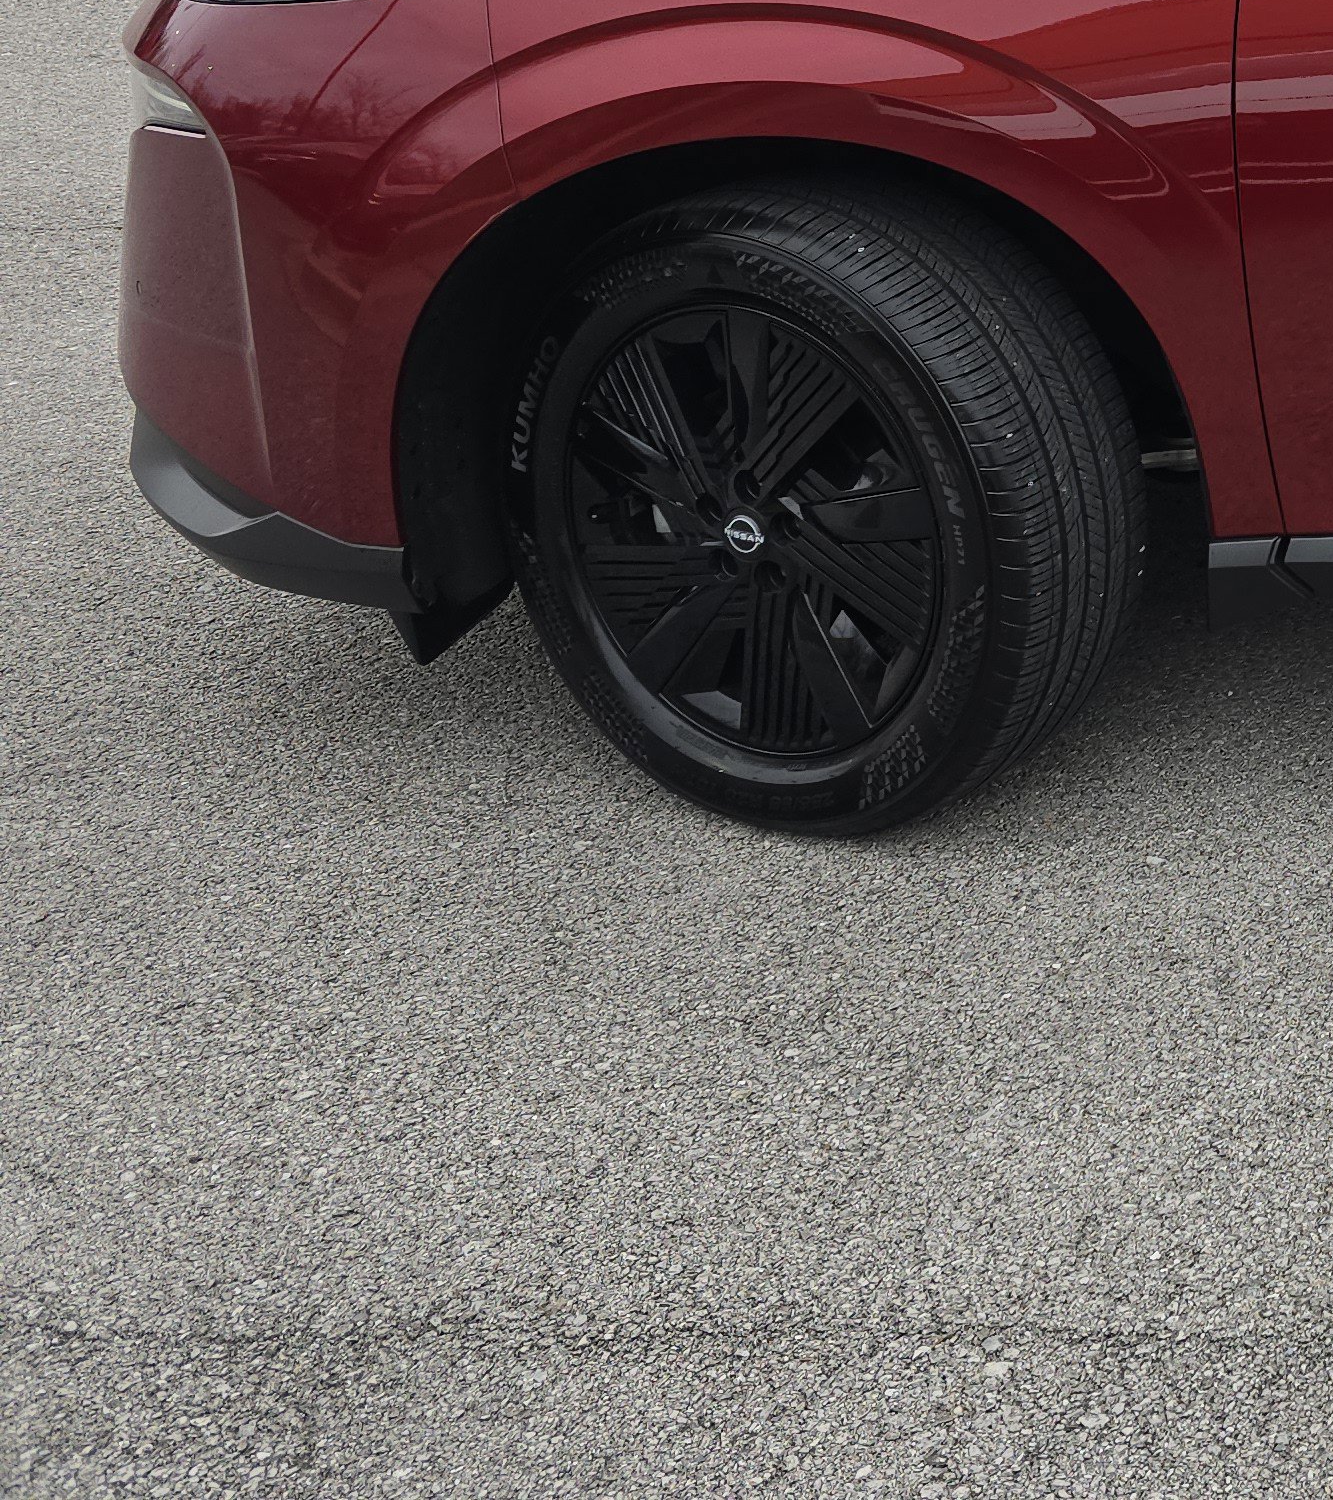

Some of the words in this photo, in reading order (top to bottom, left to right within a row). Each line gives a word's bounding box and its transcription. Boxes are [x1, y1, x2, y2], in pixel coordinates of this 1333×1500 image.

[511, 335, 559, 473] KUMHO
[871, 357, 966, 520] CRUGEN
[724, 527, 765, 544] NISSAN
